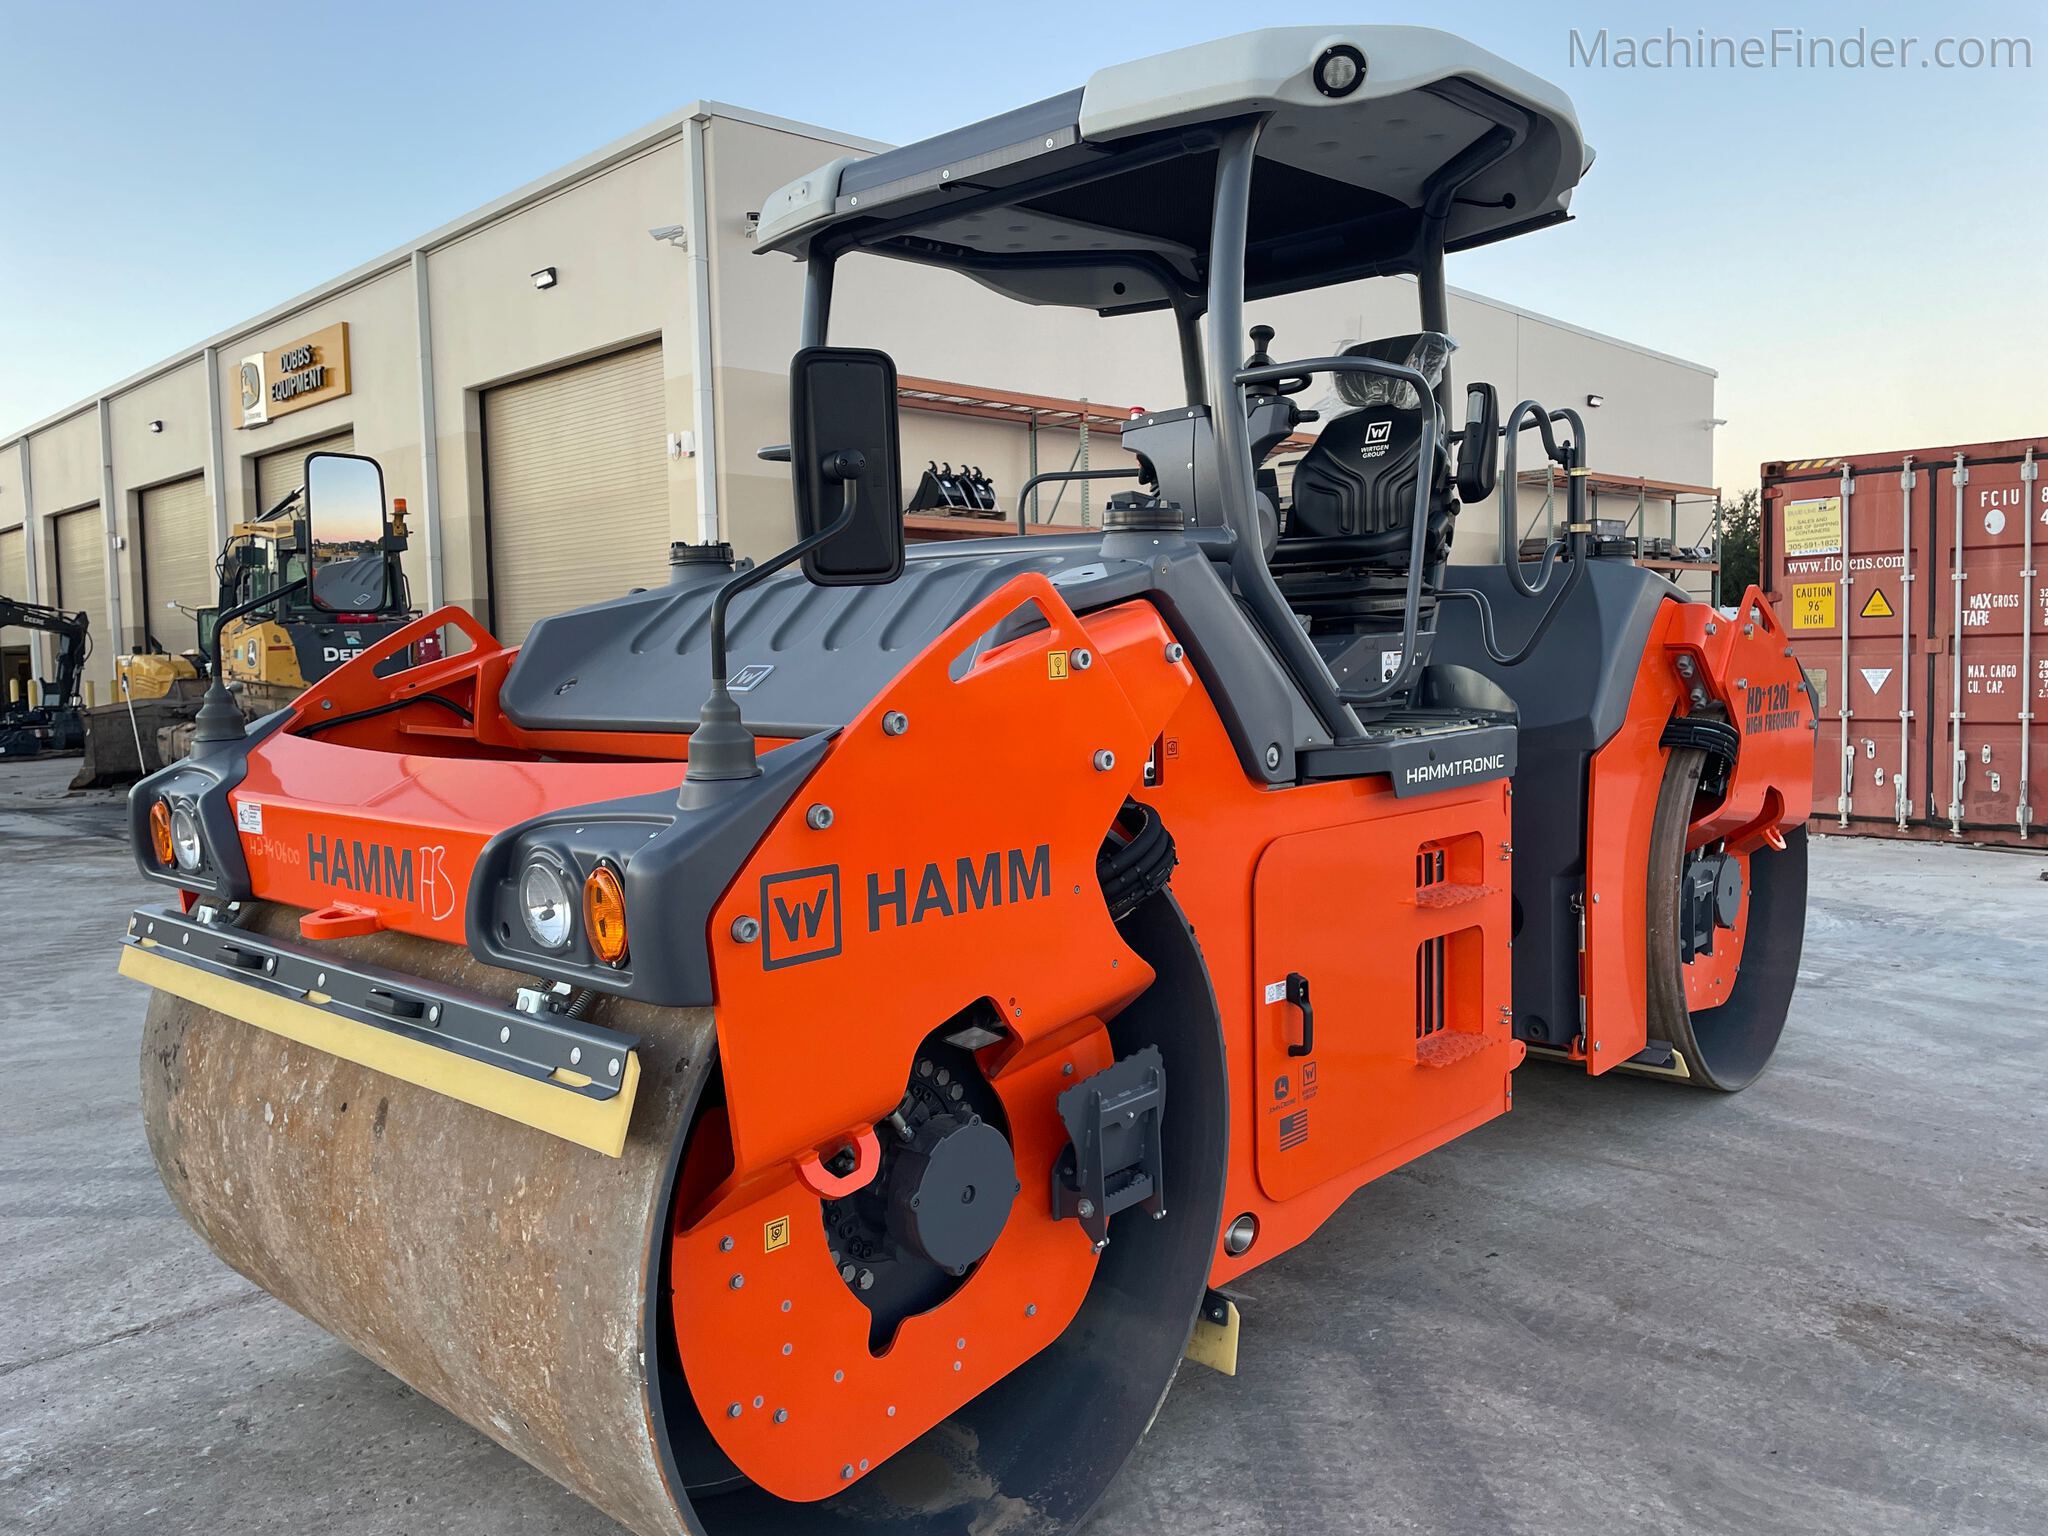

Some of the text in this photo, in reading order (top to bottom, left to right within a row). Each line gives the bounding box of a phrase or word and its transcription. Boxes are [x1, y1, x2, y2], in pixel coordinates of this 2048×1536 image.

[281, 344, 313, 373] DOBBS
[272, 366, 326, 401] EQUIPMENT
[1361, 444, 1390, 453] WIRTGEN
[1362, 451, 1386, 459] GROUP
[1980, 488, 2020, 508] FCIU
[1795, 527, 1831, 536] CONTAINERS
[1788, 555, 1905, 574] www.floens.com
[1796, 586, 1832, 598] CAUTION
[1993, 594, 2019, 608] GROSS
[1804, 614, 1824, 625] HIGH
[1962, 610, 1989, 626] TARE
[1968, 664, 1988, 678] MAX.
[1990, 664, 2017, 678] CARGO
[1968, 680, 1981, 694] CU.
[1986, 680, 2005, 694] CAP.
[1745, 710, 1801, 736] HIGH FREQUENCY
[1406, 754, 1505, 785] HAMMTRONIC
[307, 832, 414, 902] HAMM
[866, 843, 1051, 933] HAMM
